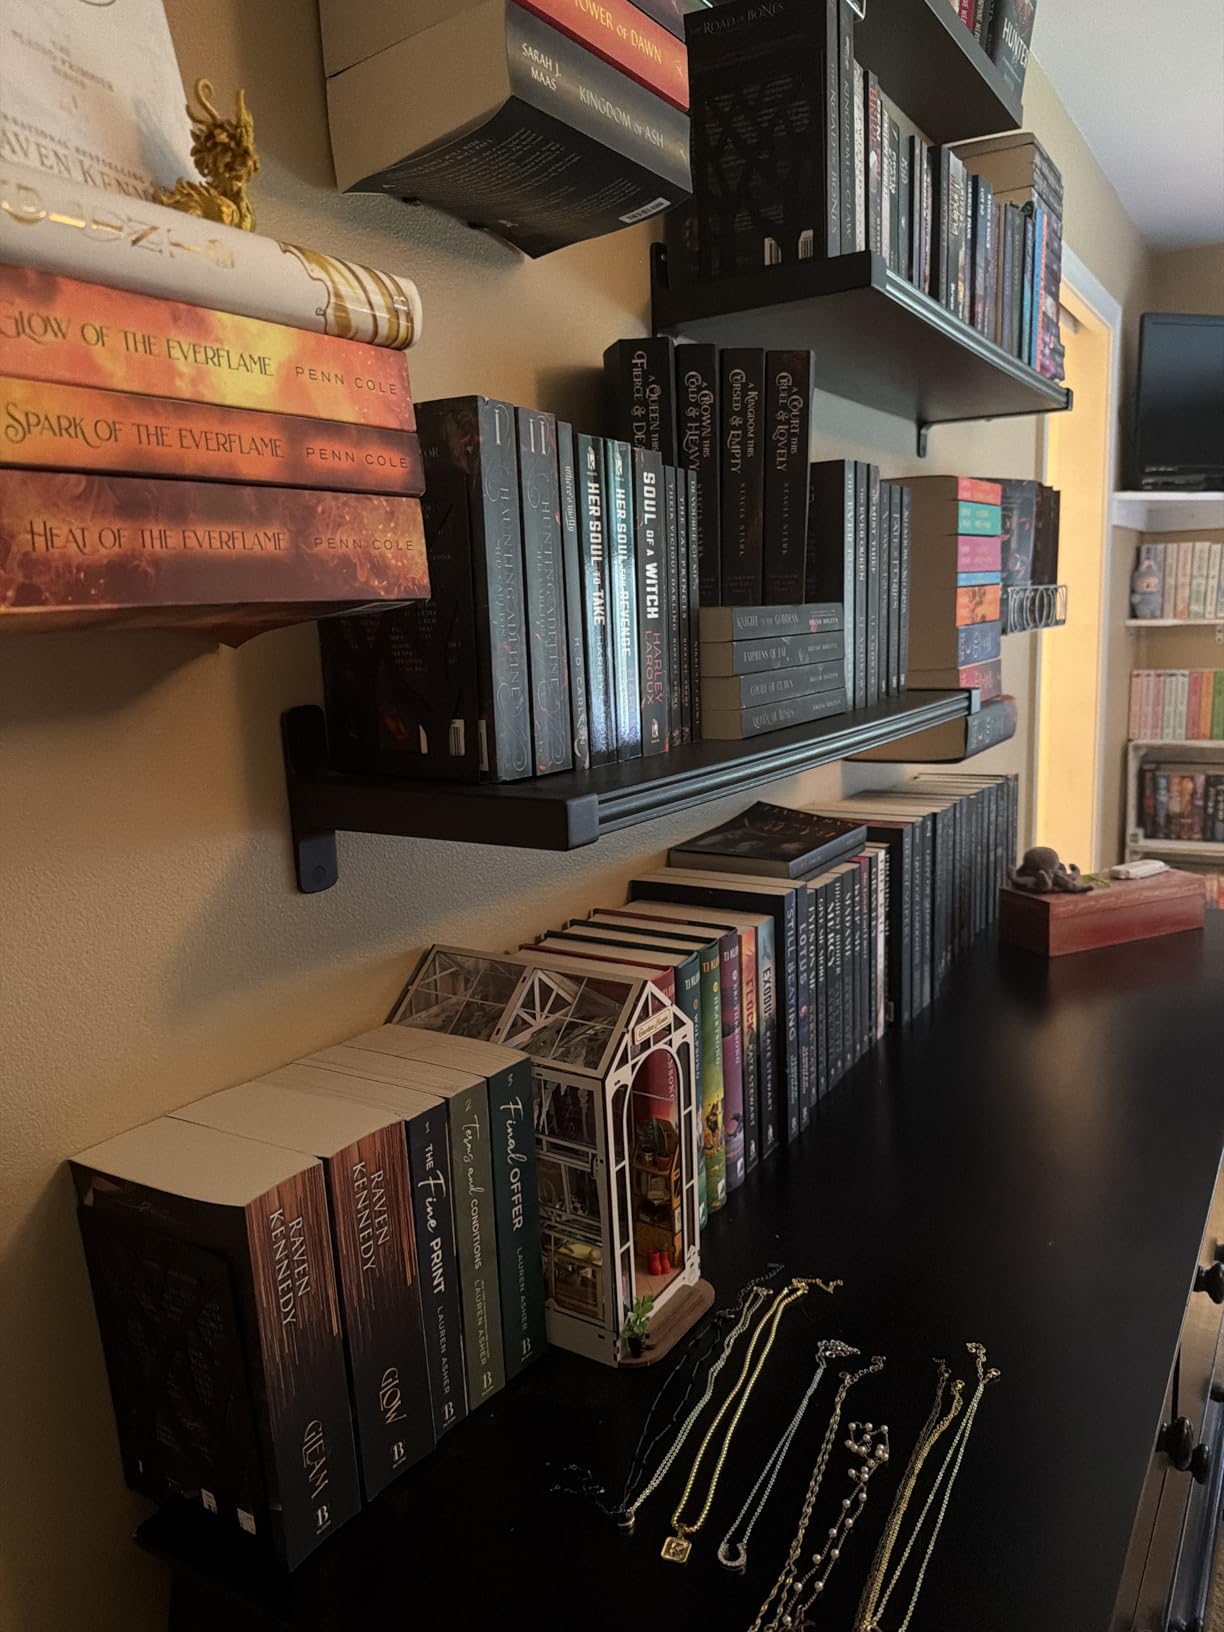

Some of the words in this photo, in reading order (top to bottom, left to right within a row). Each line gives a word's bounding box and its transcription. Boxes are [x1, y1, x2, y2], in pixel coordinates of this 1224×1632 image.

[521, 42, 552, 71] SARAH
[630, 29, 662, 65] DAWN
[531, 66, 557, 92] MAAS
[578, 84, 632, 129] KINGDOM
[643, 123, 664, 149] ASH
[0, 128, 72, 178] AVEN
[0, 310, 70, 344] GLOW
[80, 322, 111, 347] OF
[121, 331, 160, 357] THE
[166, 338, 275, 376] EVERFLAME
[295, 366, 345, 386] PENN
[353, 376, 398, 396] COLE
[632, 350, 647, 401] FIERCE
[684, 371, 702, 406] COLD
[729, 369, 746, 412] CURSED
[775, 372, 792, 406] CRUEL
[4, 402, 99, 449] SPARK
[94, 419, 121, 444] OF
[134, 426, 173, 448] THE
[179, 429, 285, 458] EVERFLAME
[633, 406, 646, 417] &
[646, 384, 662, 432] QUEEN
[687, 407, 699, 419] &
[698, 390, 714, 438] CROWN
[729, 415, 742, 430] &
[744, 391, 758, 437] KINGDOM
[777, 411, 789, 426] &
[788, 394, 803, 432] COURT
[305, 447, 355, 464] PENN
[364, 453, 409, 469] COLE
[683, 422, 701, 471] HEAVY
[727, 431, 742, 473] EMPTY
[772, 426, 789, 471] LOVELY
[588, 481, 601, 517] HER
[616, 487, 627, 521] HER
[643, 471, 657, 525] SOUL
[27, 520, 93, 557] HEAT
[98, 527, 128, 550] OF
[138, 529, 176, 550] THE
[181, 529, 288, 552] EVERFLAME
[313, 537, 361, 550] PENN
[372, 539, 414, 552] COLE
[541, 500, 555, 599] HUNTING
[589, 520, 603, 567] SOUL
[617, 523, 628, 561] SOUL
[646, 530, 655, 545] OF
[647, 550, 655, 559] A
[499, 487, 515, 602] HAUNTING
[507, 608, 521, 698] ADELINE
[592, 589, 606, 626] TAKE
[645, 562, 660, 619] WITCH
[619, 590, 632, 657] REVENGE
[547, 607, 560, 689] ADELINE
[644, 631, 655, 705] LAROUX
[653, 632, 663, 703] HARLEY
[786, 908, 797, 959] STILL
[808, 906, 816, 943] EYES
[827, 901, 835, 967] MERCY
[799, 922, 808, 985] LOTUS
[732, 983, 740, 1064] BROTHERSONG
[745, 979, 755, 1033] FLOCK
[787, 961, 798, 1041] BEATING
[712, 995, 720, 1065] HEARTSONG
[766, 1030, 774, 1057] KATE
[747, 1043, 755, 1073] KATE
[748, 1075, 756, 1127] STEWART
[766, 1061, 774, 1112] STEWART
[461, 1114, 480, 1163] Terms
[500, 1096, 528, 1165] Final
[424, 1143, 434, 1170] THE
[418, 1170, 446, 1233] Fine
[466, 1167, 485, 1196] and
[509, 1167, 524, 1232] OFFER
[352, 1161, 377, 1271] KENNEDY
[370, 1169, 390, 1246] RAVEN
[289, 1216, 311, 1297] RAVEN
[470, 1198, 483, 1271] CONDITIONS
[270, 1208, 297, 1325] KENNEDY
[429, 1237, 445, 1295] PRINT
[517, 1247, 526, 1293] LAUREN
[474, 1279, 483, 1327] LAUREN
[520, 1295, 530, 1331] ASHER
[437, 1305, 448, 1353] LAUREN
[477, 1329, 487, 1366] ASHER
[380, 1367, 408, 1425] GLOW
[441, 1357, 451, 1396] ASHER
[302, 1419, 329, 1501] GLEAM
